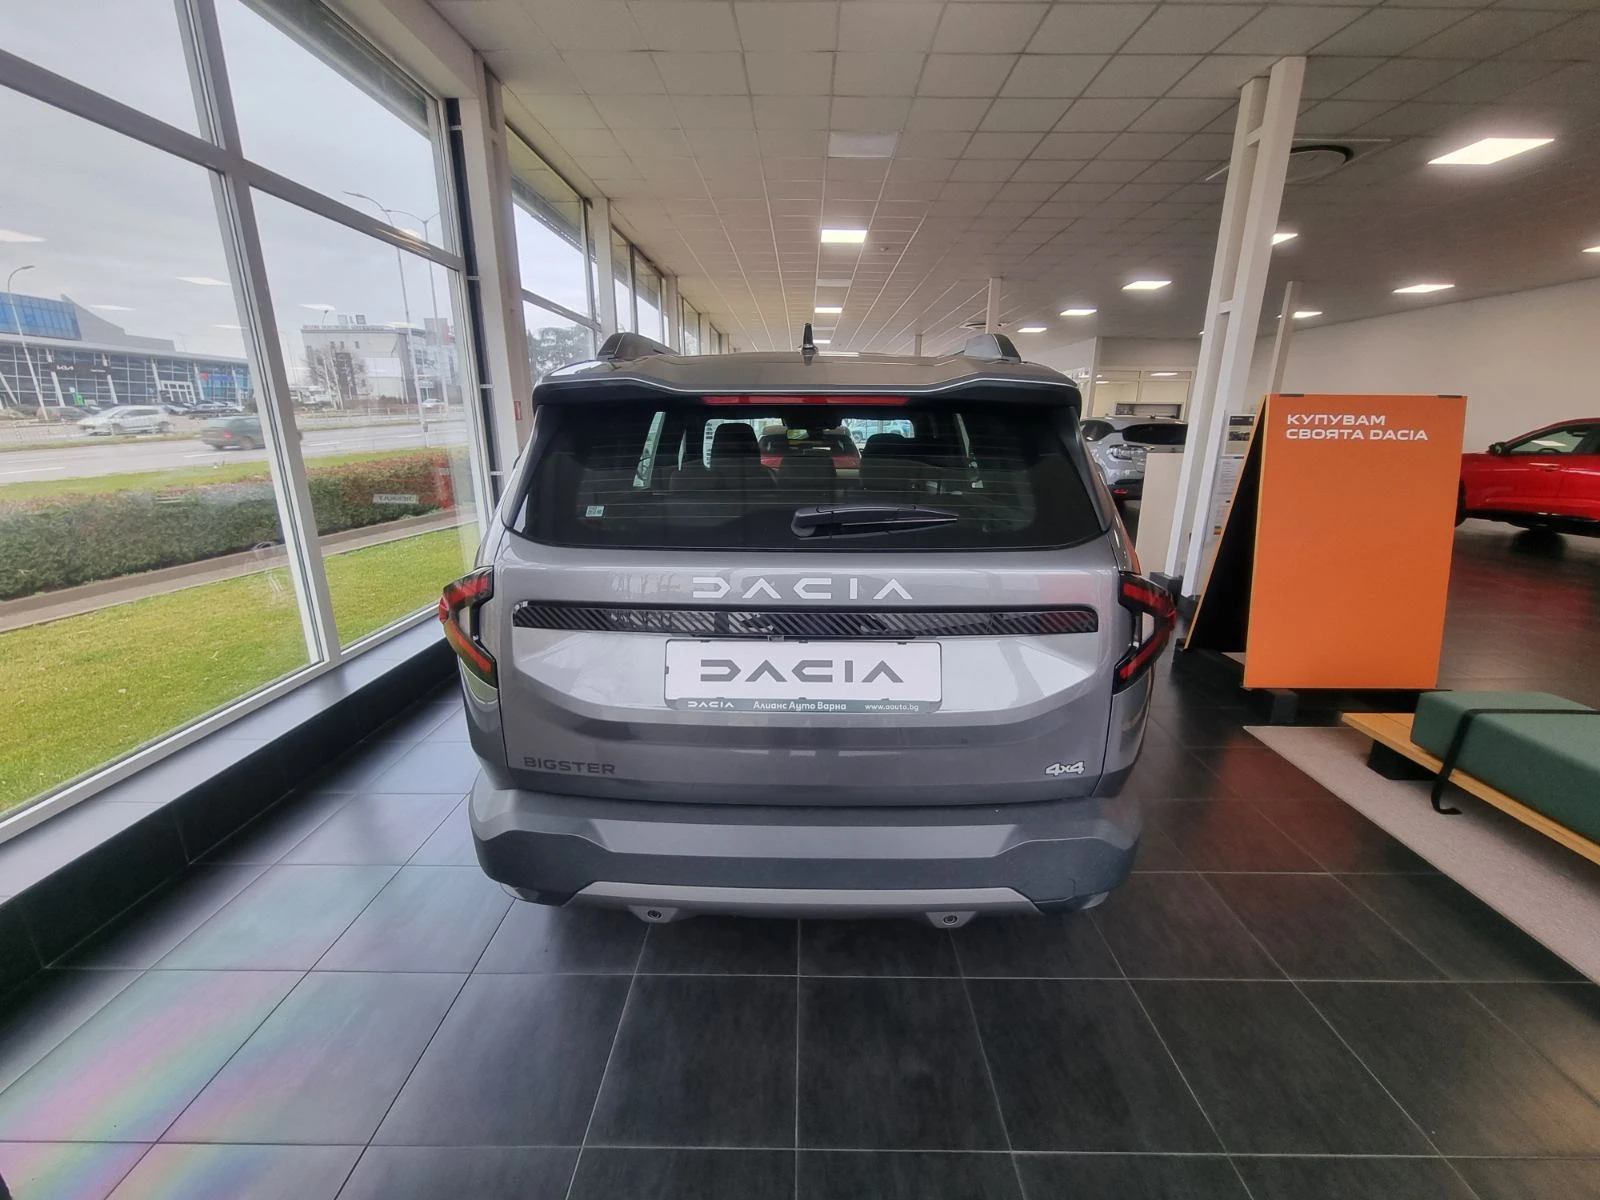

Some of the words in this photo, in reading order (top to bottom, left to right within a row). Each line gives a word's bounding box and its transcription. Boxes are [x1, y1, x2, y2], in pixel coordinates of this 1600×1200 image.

[1287, 414, 1386, 426] КУПУВАМ
[1286, 428, 1364, 440] СВОЯТА
[1369, 429, 1428, 441] DACIA
[692, 576, 913, 600] DACIA
[700, 659, 904, 683] DACIA
[687, 700, 734, 708] DACIA
[753, 700, 787, 710] Алианс
[788, 701, 816, 711] Ауто
[817, 701, 847, 711] Варна
[864, 703, 919, 712] www.aauto.bg
[523, 756, 616, 774] BIGSTER
[1045, 761, 1085, 776] 4x4
